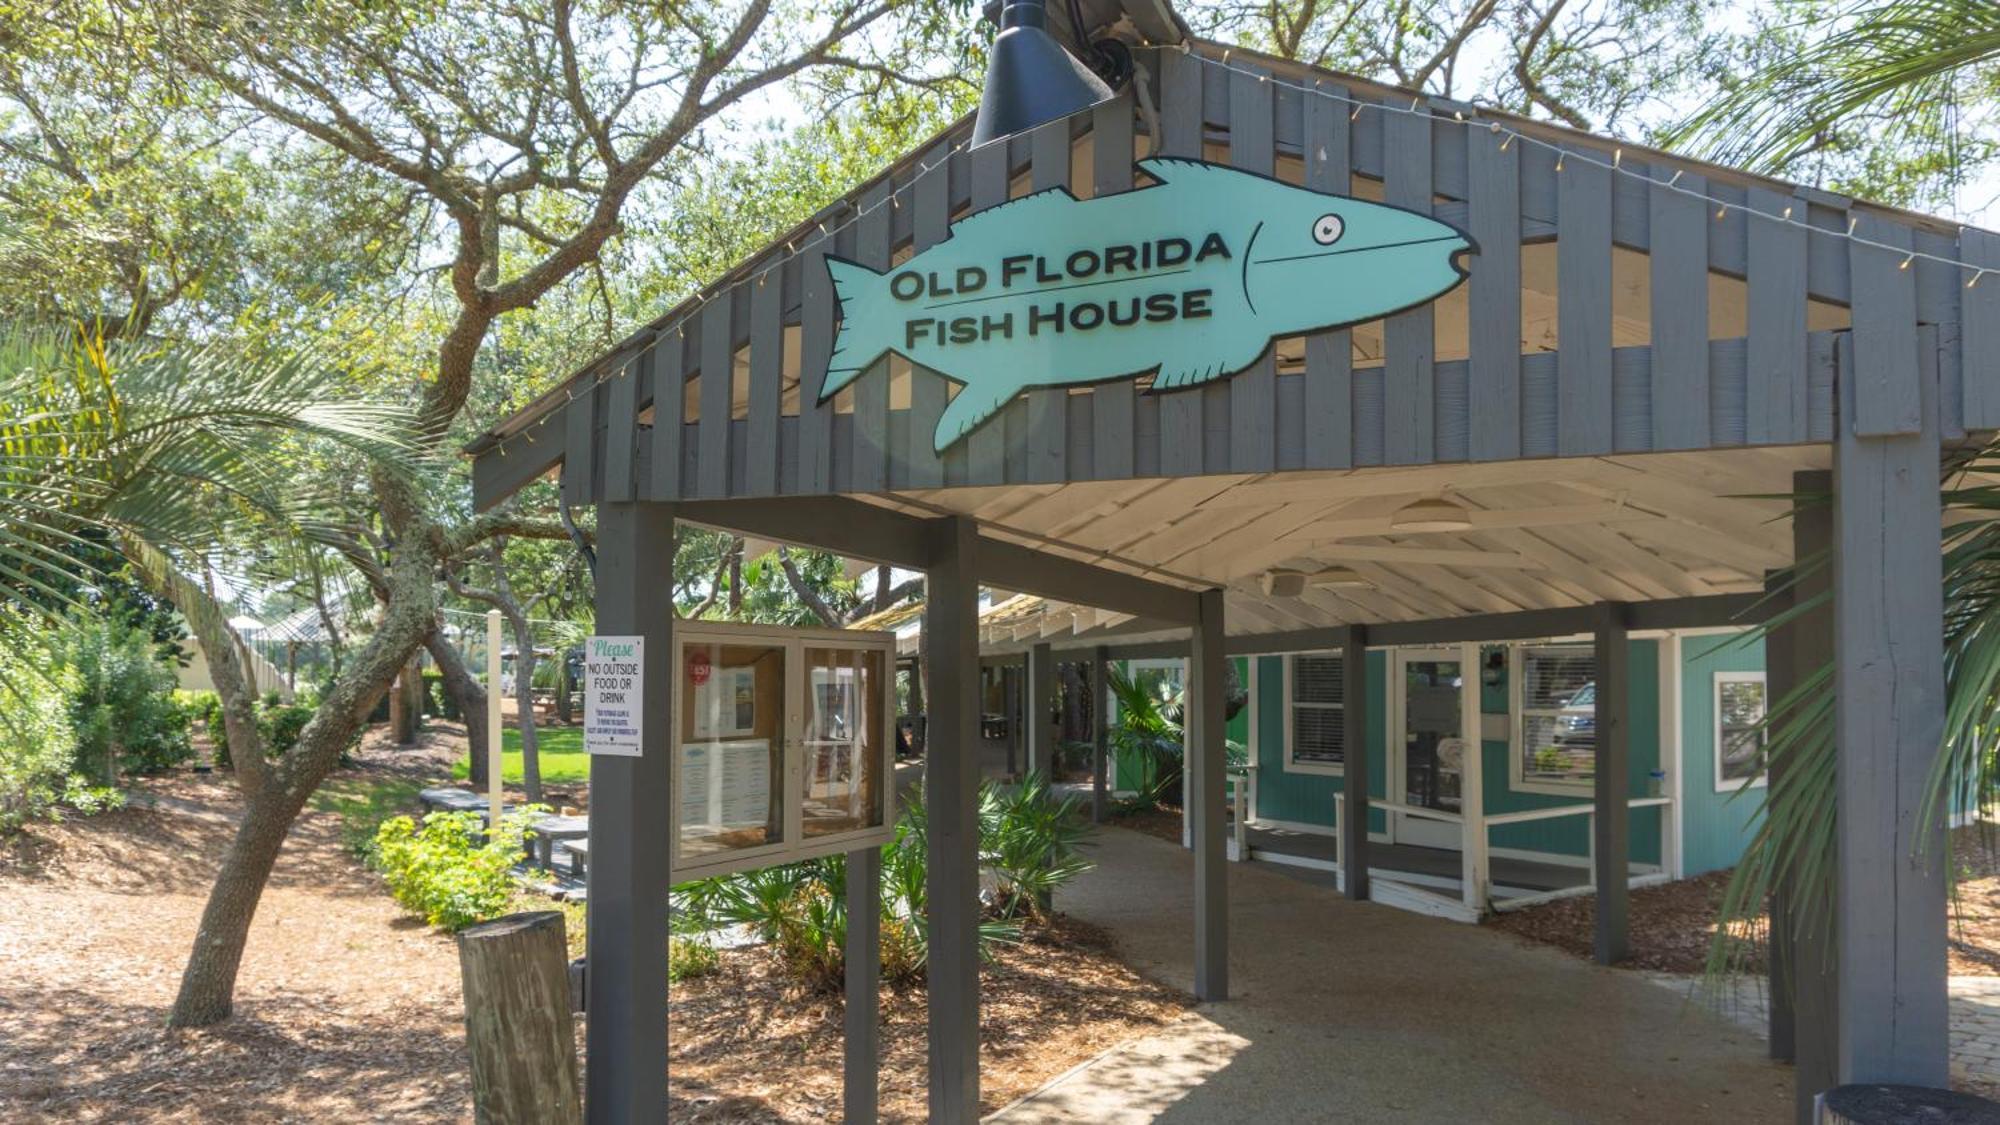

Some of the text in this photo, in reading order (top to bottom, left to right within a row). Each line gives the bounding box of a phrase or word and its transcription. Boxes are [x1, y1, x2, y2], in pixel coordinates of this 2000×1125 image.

[891, 232, 1232, 302] OLD FLORIDA
[905, 288, 1213, 350] FISH HOUSE
[594, 640, 634, 657] Please
[589, 663, 639, 676] NO OUTSIDE
[594, 678, 632, 690] FOOD OR
[600, 692, 625, 704] DRINK
